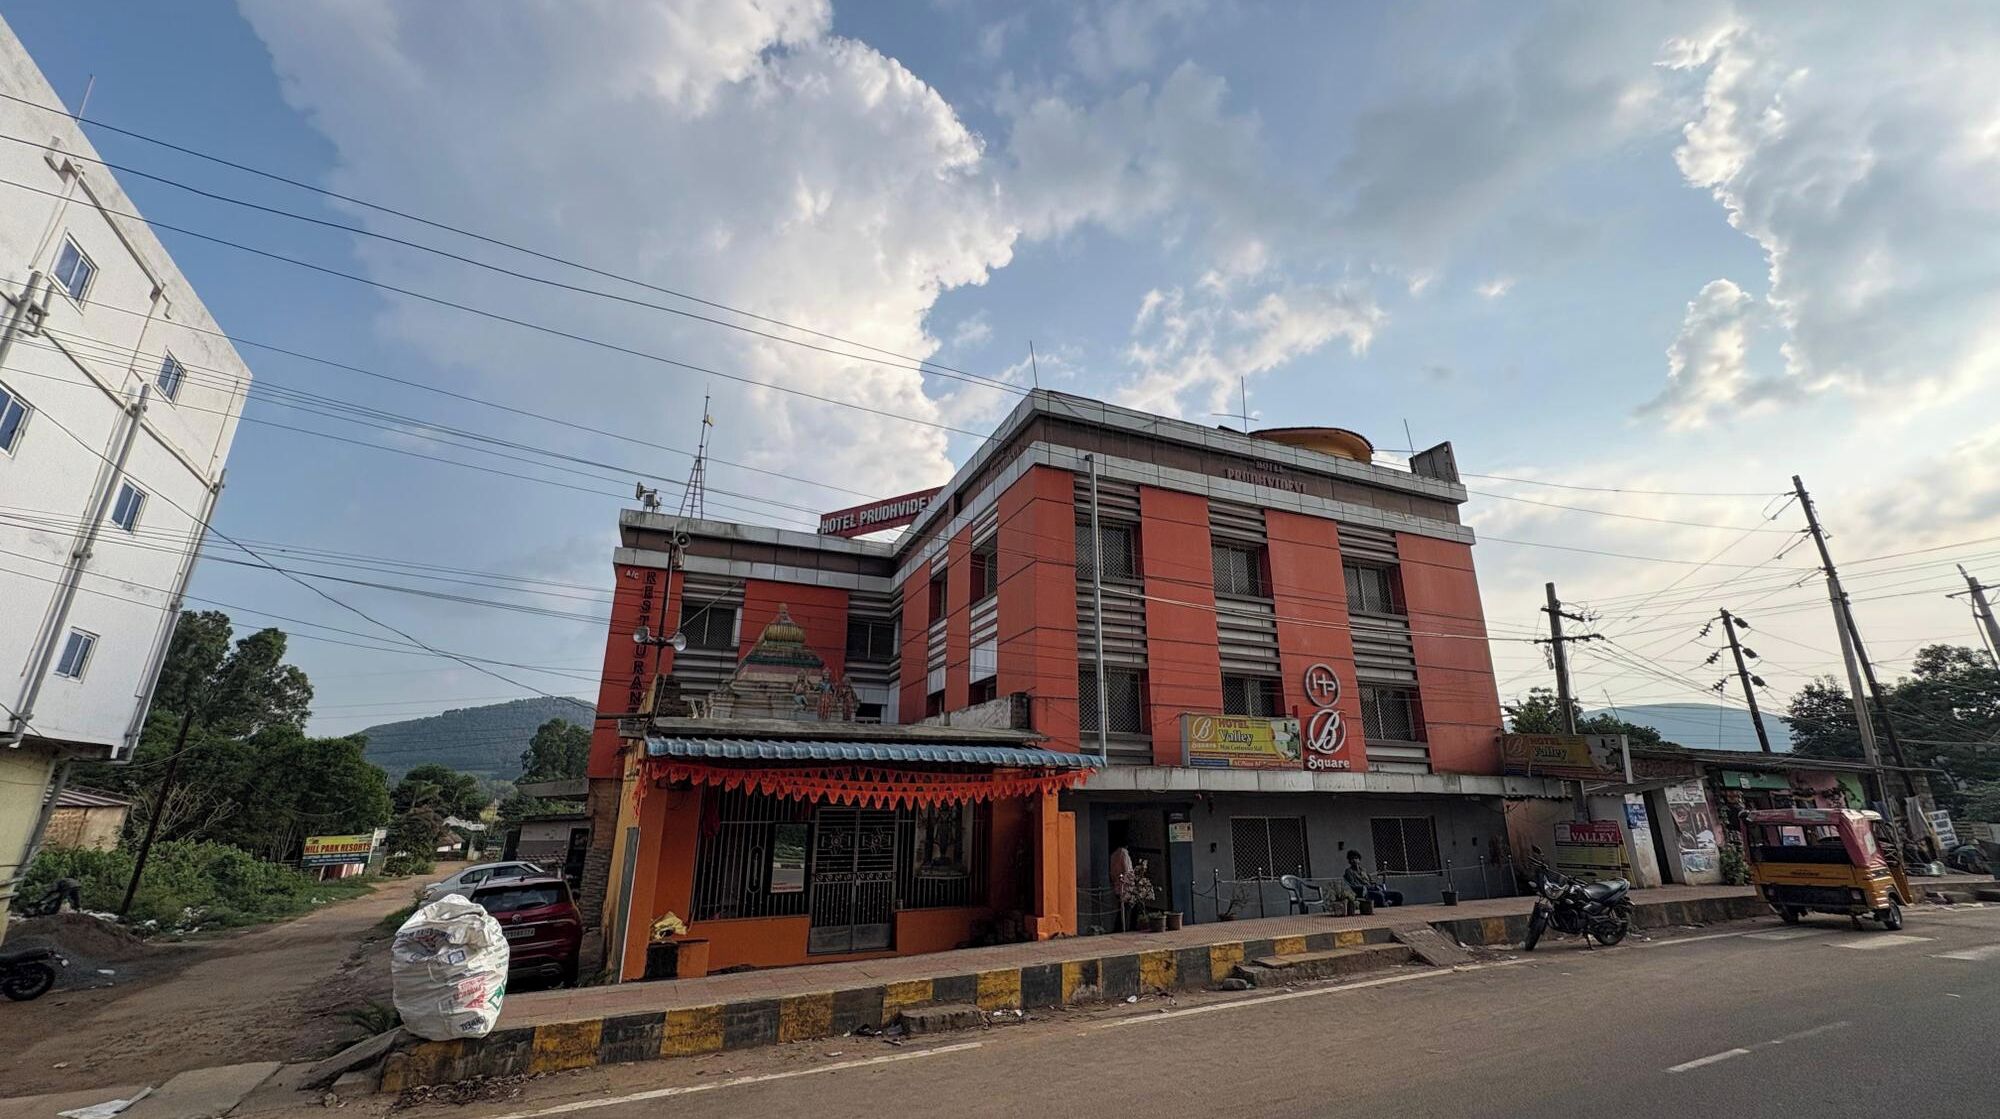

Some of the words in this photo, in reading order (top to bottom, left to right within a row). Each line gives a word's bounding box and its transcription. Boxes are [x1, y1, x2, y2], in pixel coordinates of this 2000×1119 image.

[821, 513, 857, 534] HOTEL
[859, 495, 937, 525] PRUDHVIDE
[627, 571, 657, 714] RESTURANT
[1218, 718, 1249, 729] HOTEL
[1219, 728, 1254, 746] Valley
[1308, 755, 1351, 770] Square
[1571, 831, 1614, 842] VALLEY
[305, 844, 320, 854] HILL
[321, 843, 339, 853] PARK
[340, 842, 371, 852] RESORTS
